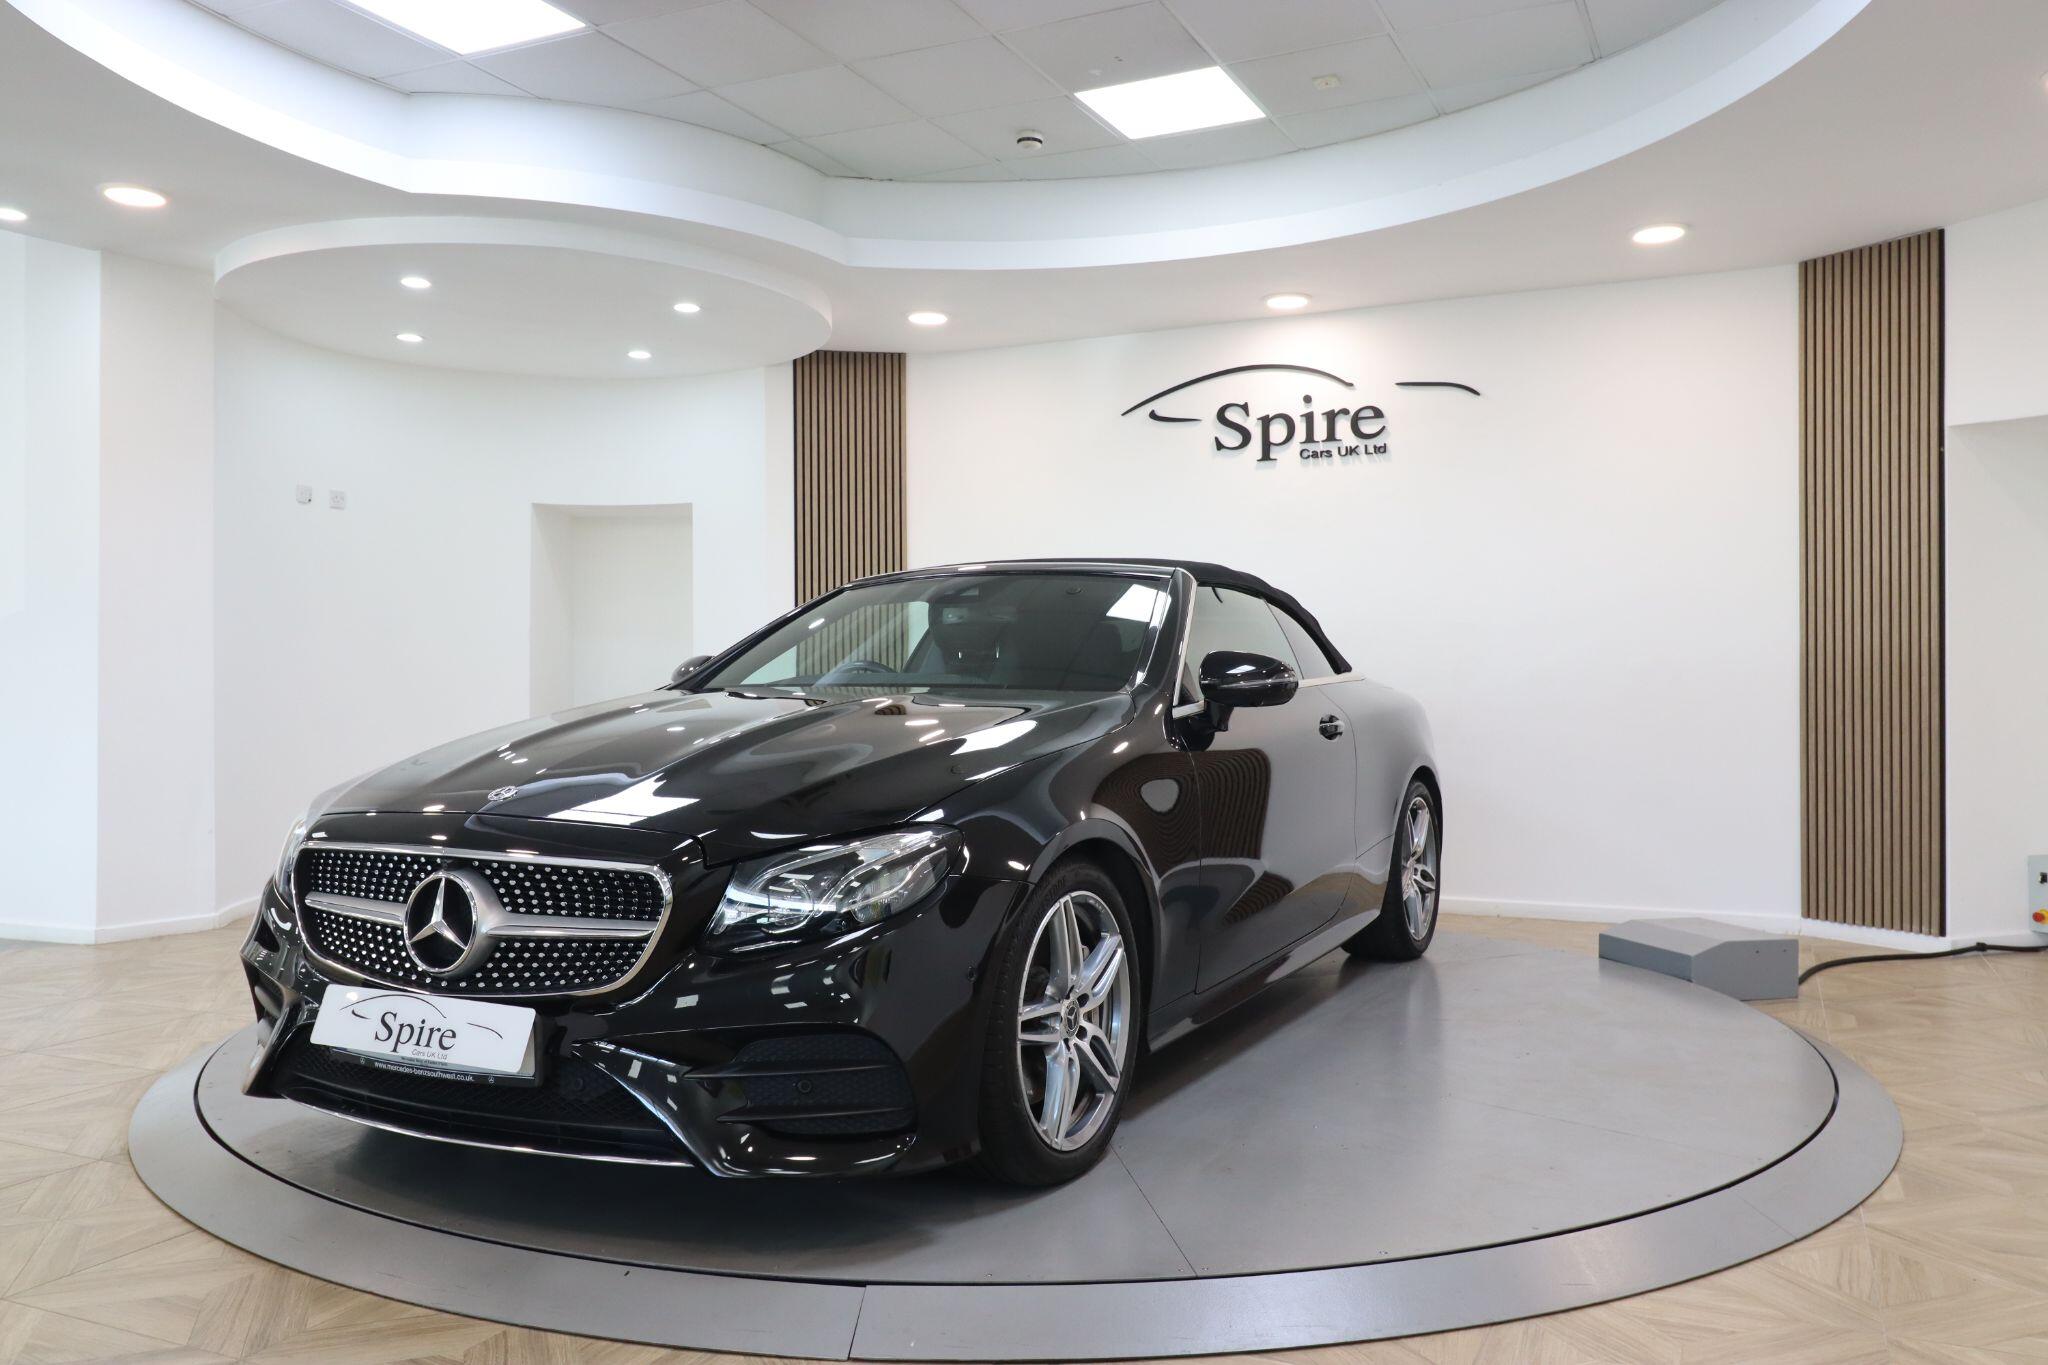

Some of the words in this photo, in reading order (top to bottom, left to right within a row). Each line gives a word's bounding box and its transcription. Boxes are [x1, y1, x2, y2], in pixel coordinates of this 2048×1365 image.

[1214, 394, 1387, 462] Spire
[1299, 448, 1333, 460] Cars
[1337, 445, 1360, 457] UK
[1364, 443, 1387, 455] Ltd
[374, 1011, 457, 1053] Spire
[411, 1048, 426, 1057] Cars
[426, 1050, 436, 1059] UK
[437, 1052, 448, 1060] Ltd
